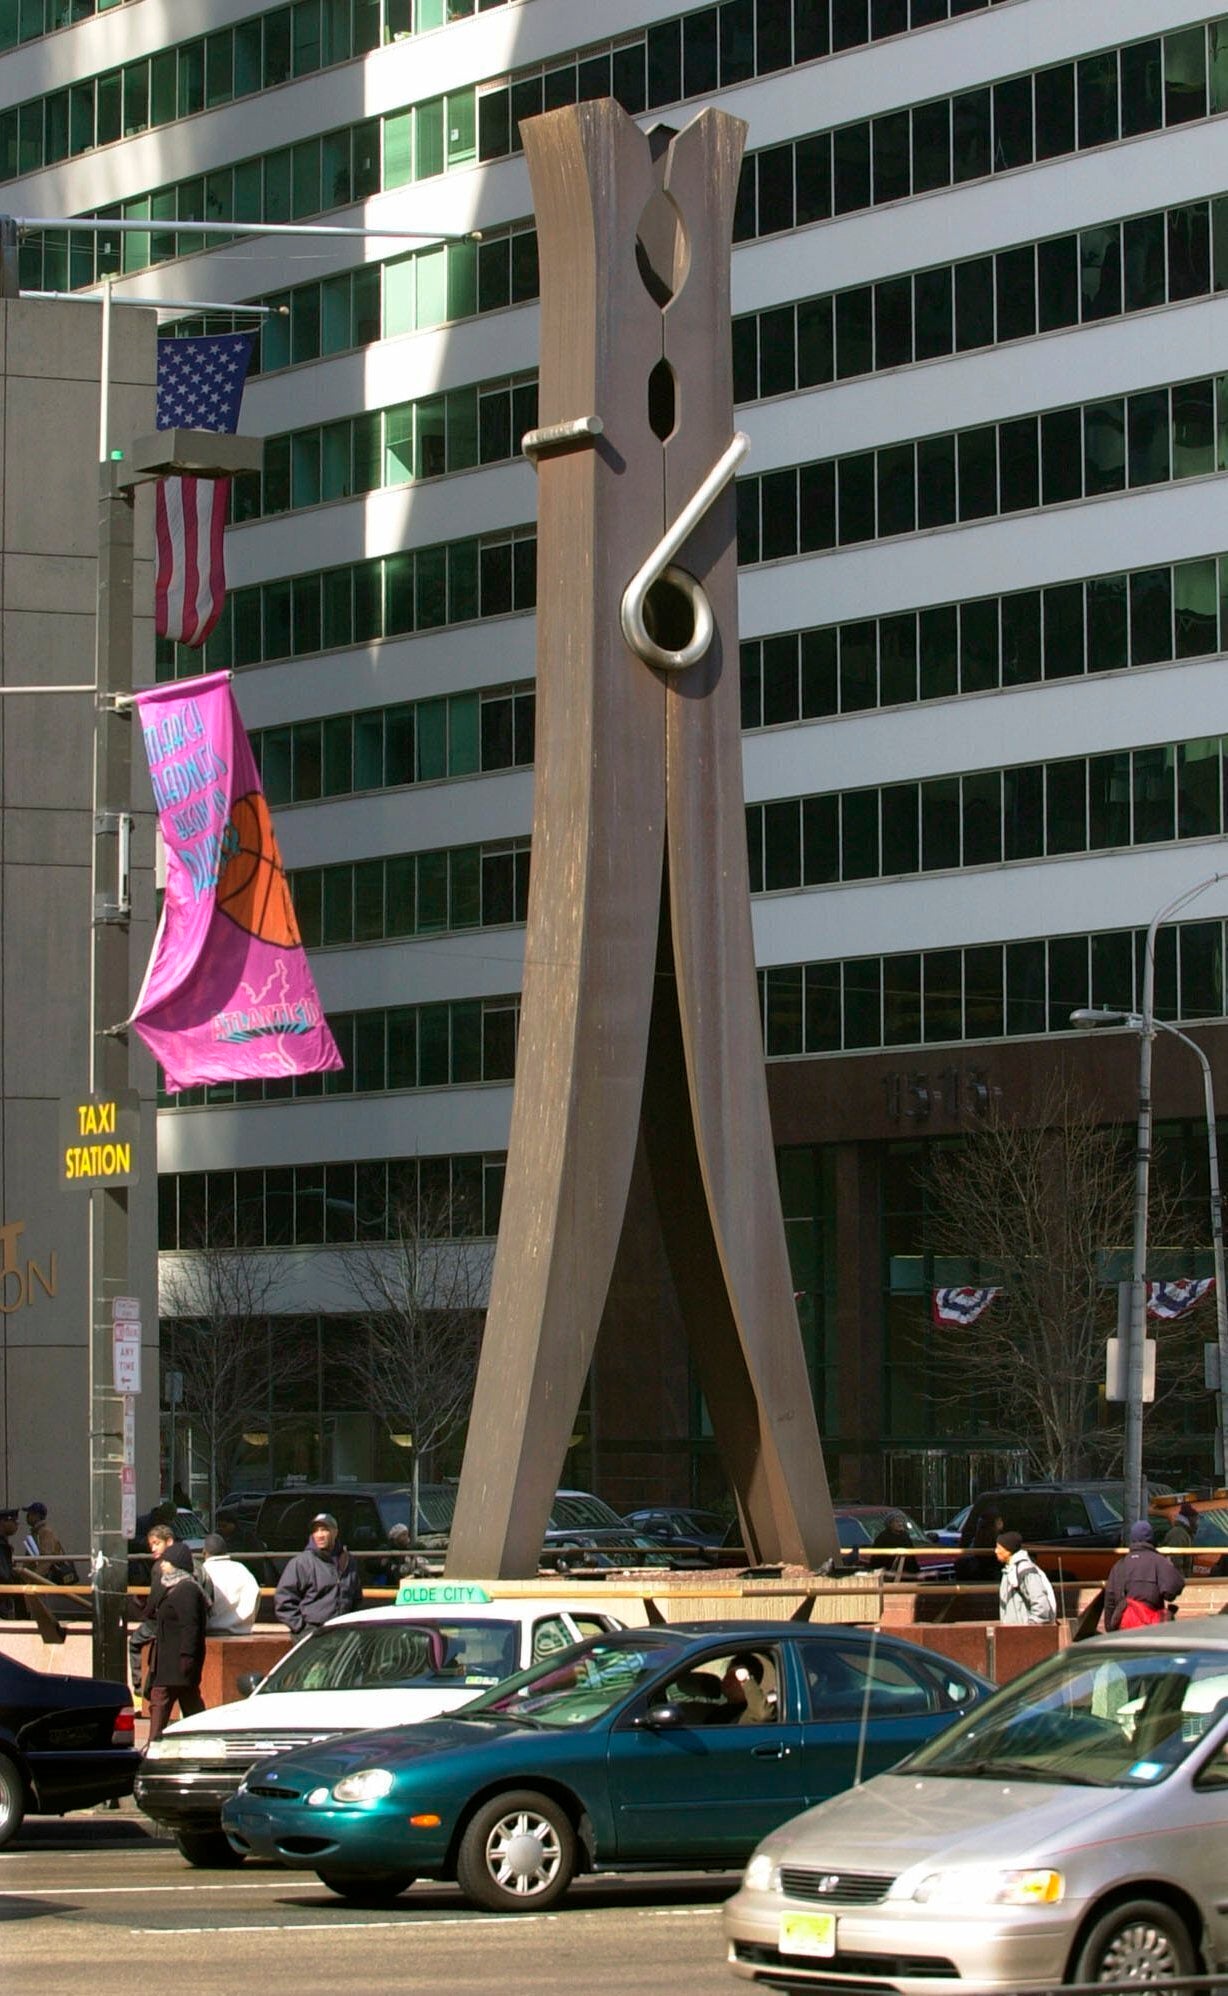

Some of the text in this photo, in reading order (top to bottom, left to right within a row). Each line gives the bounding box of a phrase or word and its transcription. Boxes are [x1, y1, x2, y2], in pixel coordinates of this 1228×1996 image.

[144, 699, 205, 765] MARCH
[212, 1003, 301, 1041] ATLANTIC
[79, 1102, 116, 1136] TAXI
[66, 1143, 131, 1179] STATION
[403, 1586, 475, 1602] OLDE CITY
